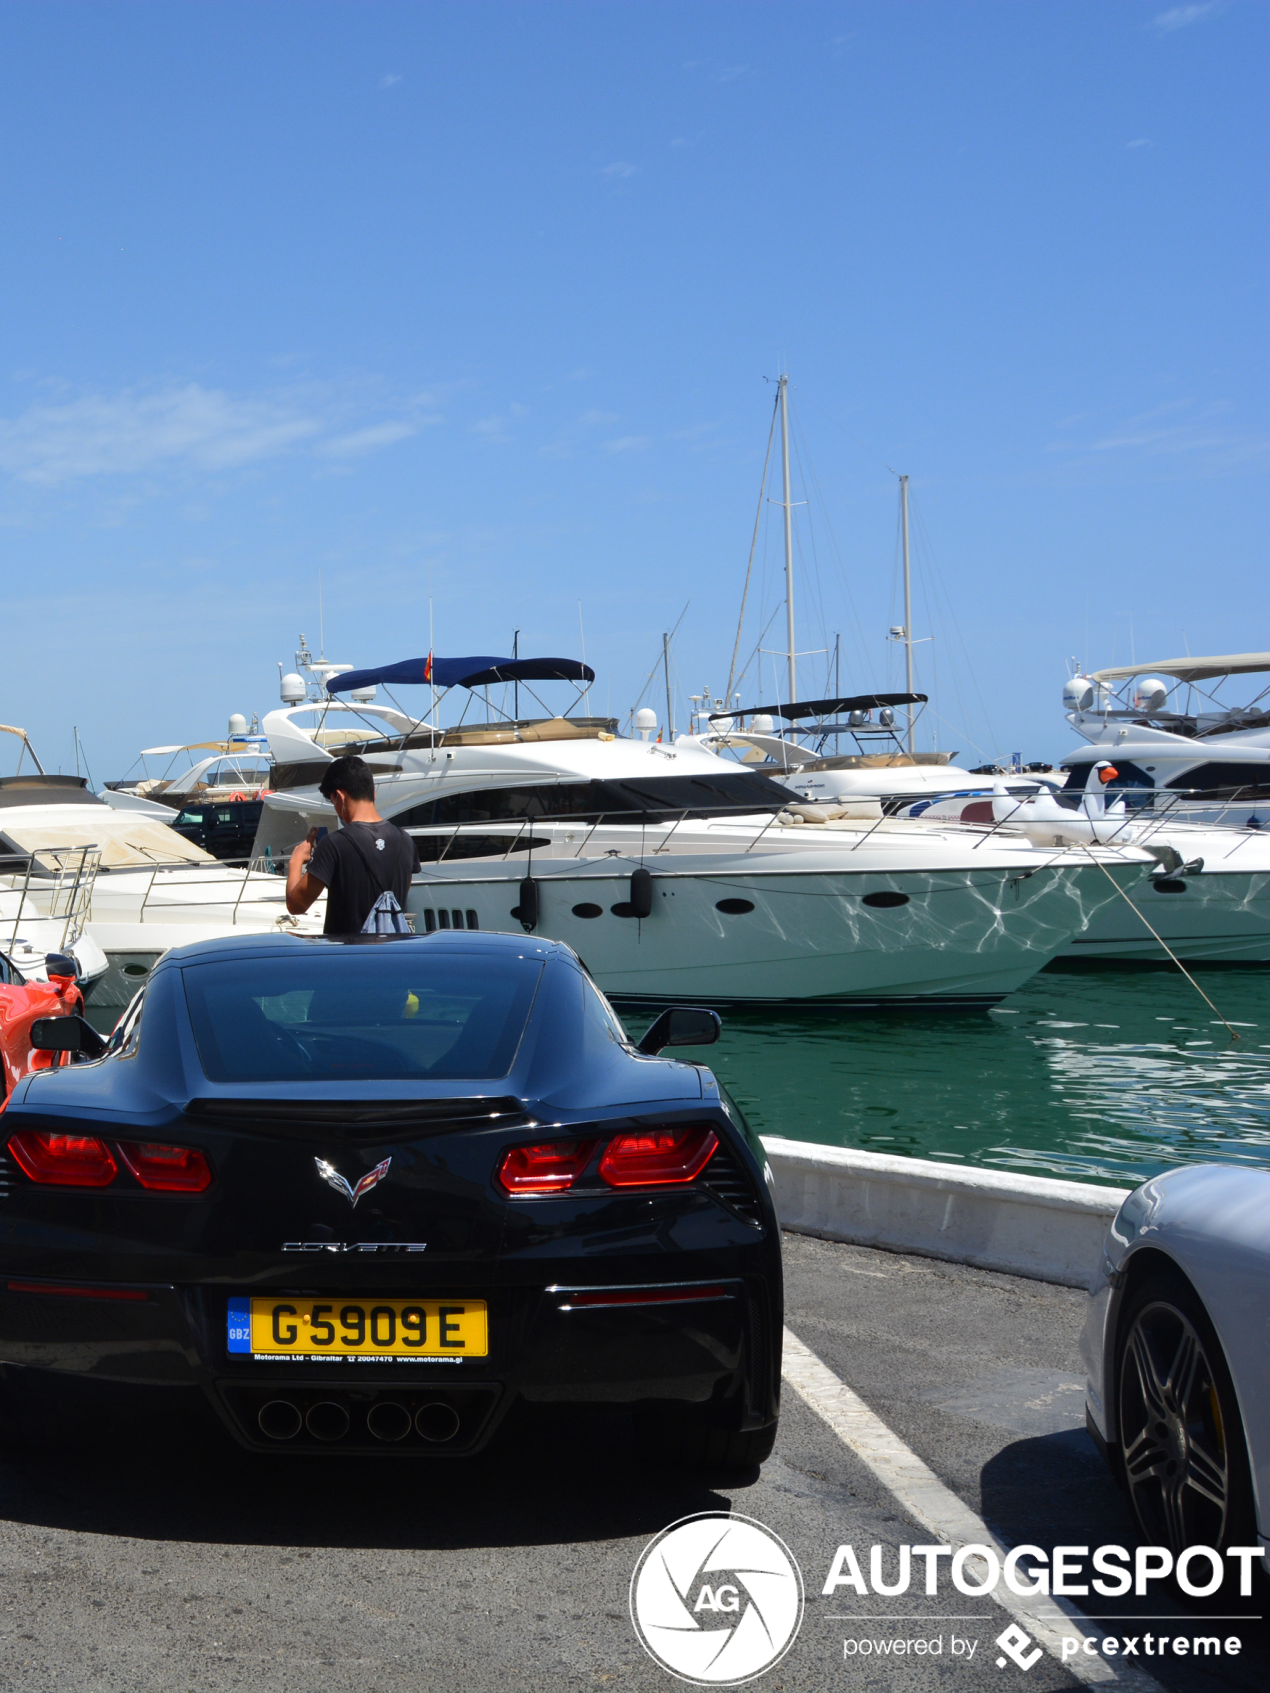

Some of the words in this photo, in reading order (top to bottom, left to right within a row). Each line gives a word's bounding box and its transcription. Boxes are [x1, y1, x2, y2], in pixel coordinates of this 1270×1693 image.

[272, 1304, 298, 1345] G
[310, 1305, 427, 1348] 5909
[440, 1307, 466, 1348] E
[229, 1328, 250, 1340] GBZ
[311, 1354, 343, 1362] Gibraltar
[396, 1356, 463, 1364] www.motorama.gi
